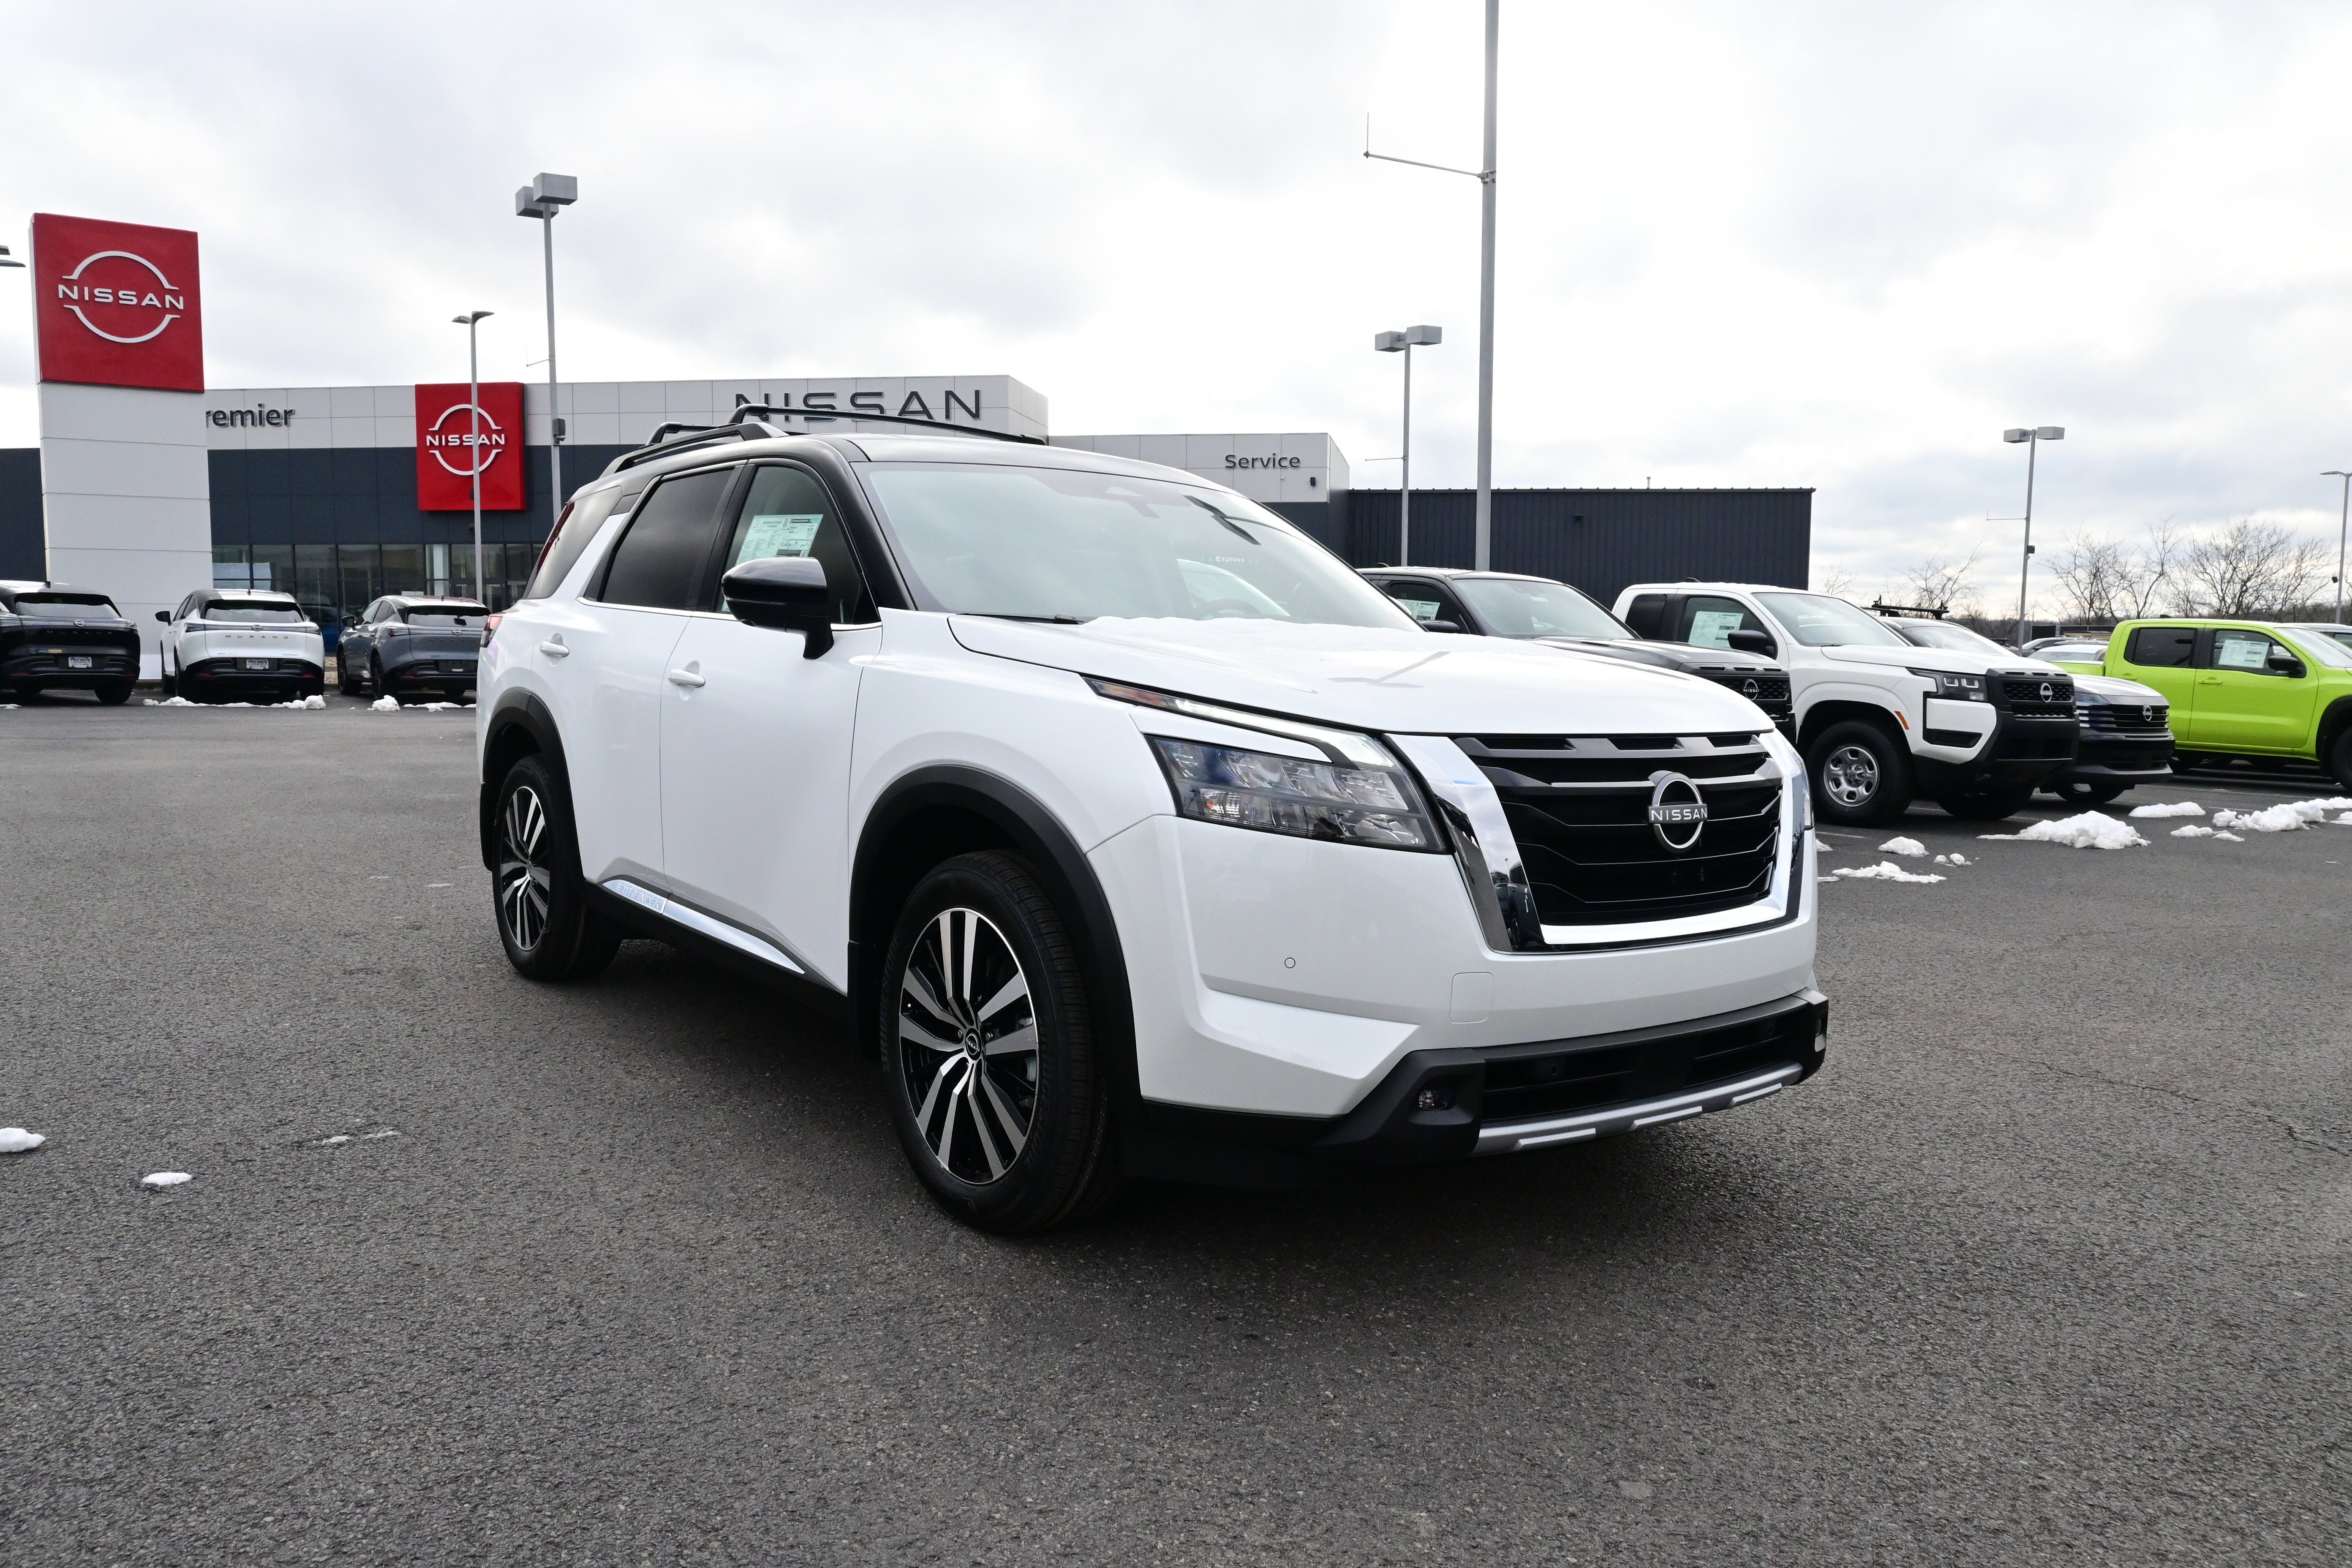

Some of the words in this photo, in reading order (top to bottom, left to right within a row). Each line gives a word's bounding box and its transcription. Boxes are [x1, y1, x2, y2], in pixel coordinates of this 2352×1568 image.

[58, 284, 184, 310] NISSAN
[206, 403, 295, 427] remier
[736, 389, 981, 422] NISSAN
[426, 434, 505, 446] NISSAN
[1225, 453, 1301, 469] Service
[1651, 807, 1708, 821] NISSAN
[616, 882, 662, 909] PATHFINDER
